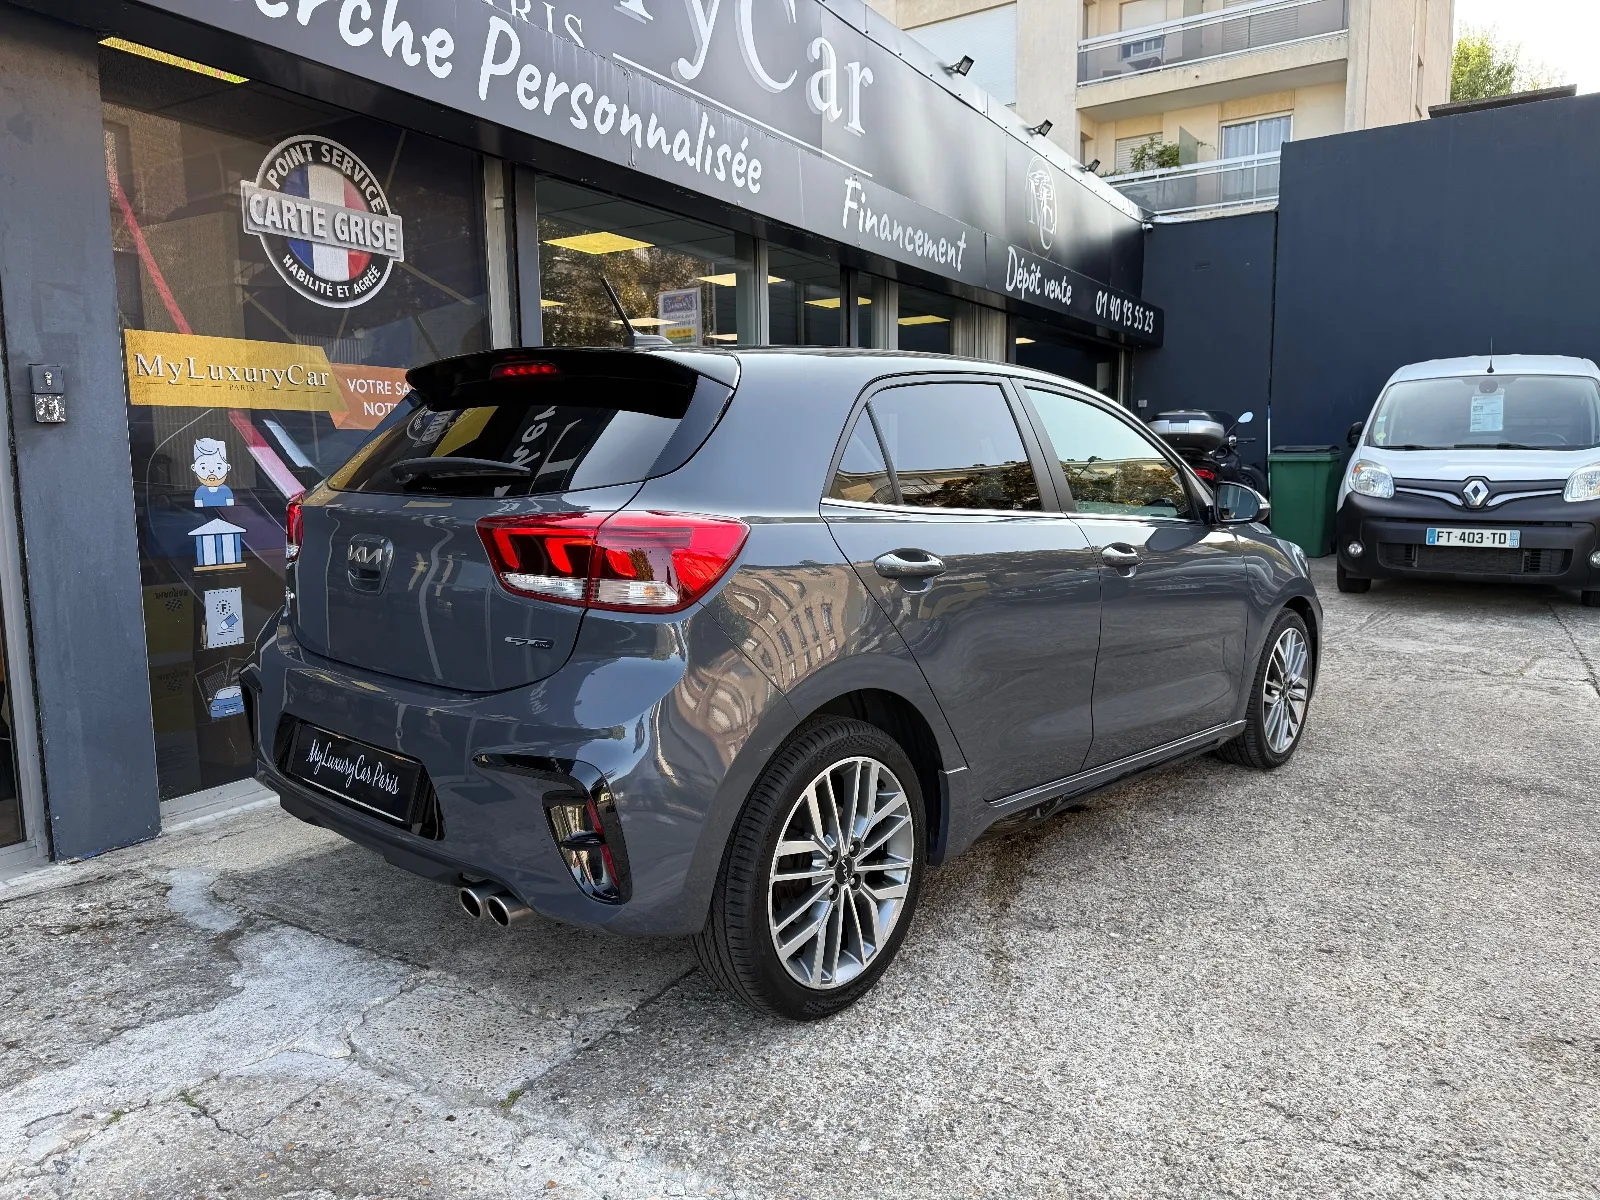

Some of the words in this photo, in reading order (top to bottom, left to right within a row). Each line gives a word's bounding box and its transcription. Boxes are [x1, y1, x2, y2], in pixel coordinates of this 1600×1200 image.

[482, 0, 585, 49] RIS
[614, 0, 873, 137] yCar
[477, 15, 763, 194] Personnalisée
[265, 142, 314, 190] POINT
[320, 143, 385, 213] SERVICE
[249, 193, 328, 238] CARTE
[334, 211, 399, 252] GRISE
[842, 176, 967, 273] Financement
[282, 253, 334, 297] HABILITÉ
[336, 285, 351, 298] ET
[1005, 245, 1042, 300] Dépôt
[1044, 275, 1072, 306] vente
[1095, 290, 1108, 319] 01
[1109, 294, 1121, 322] 40
[1122, 299, 1133, 327] 93
[1133, 304, 1144, 330] 55
[1144, 310, 1154, 334] 23
[133, 352, 330, 389] MyLuxuryCar
[228, 383, 256, 393] PARIS
[346, 377, 392, 395] VOTRE
[1436, 530, 1507, 545] FT-403-TD
